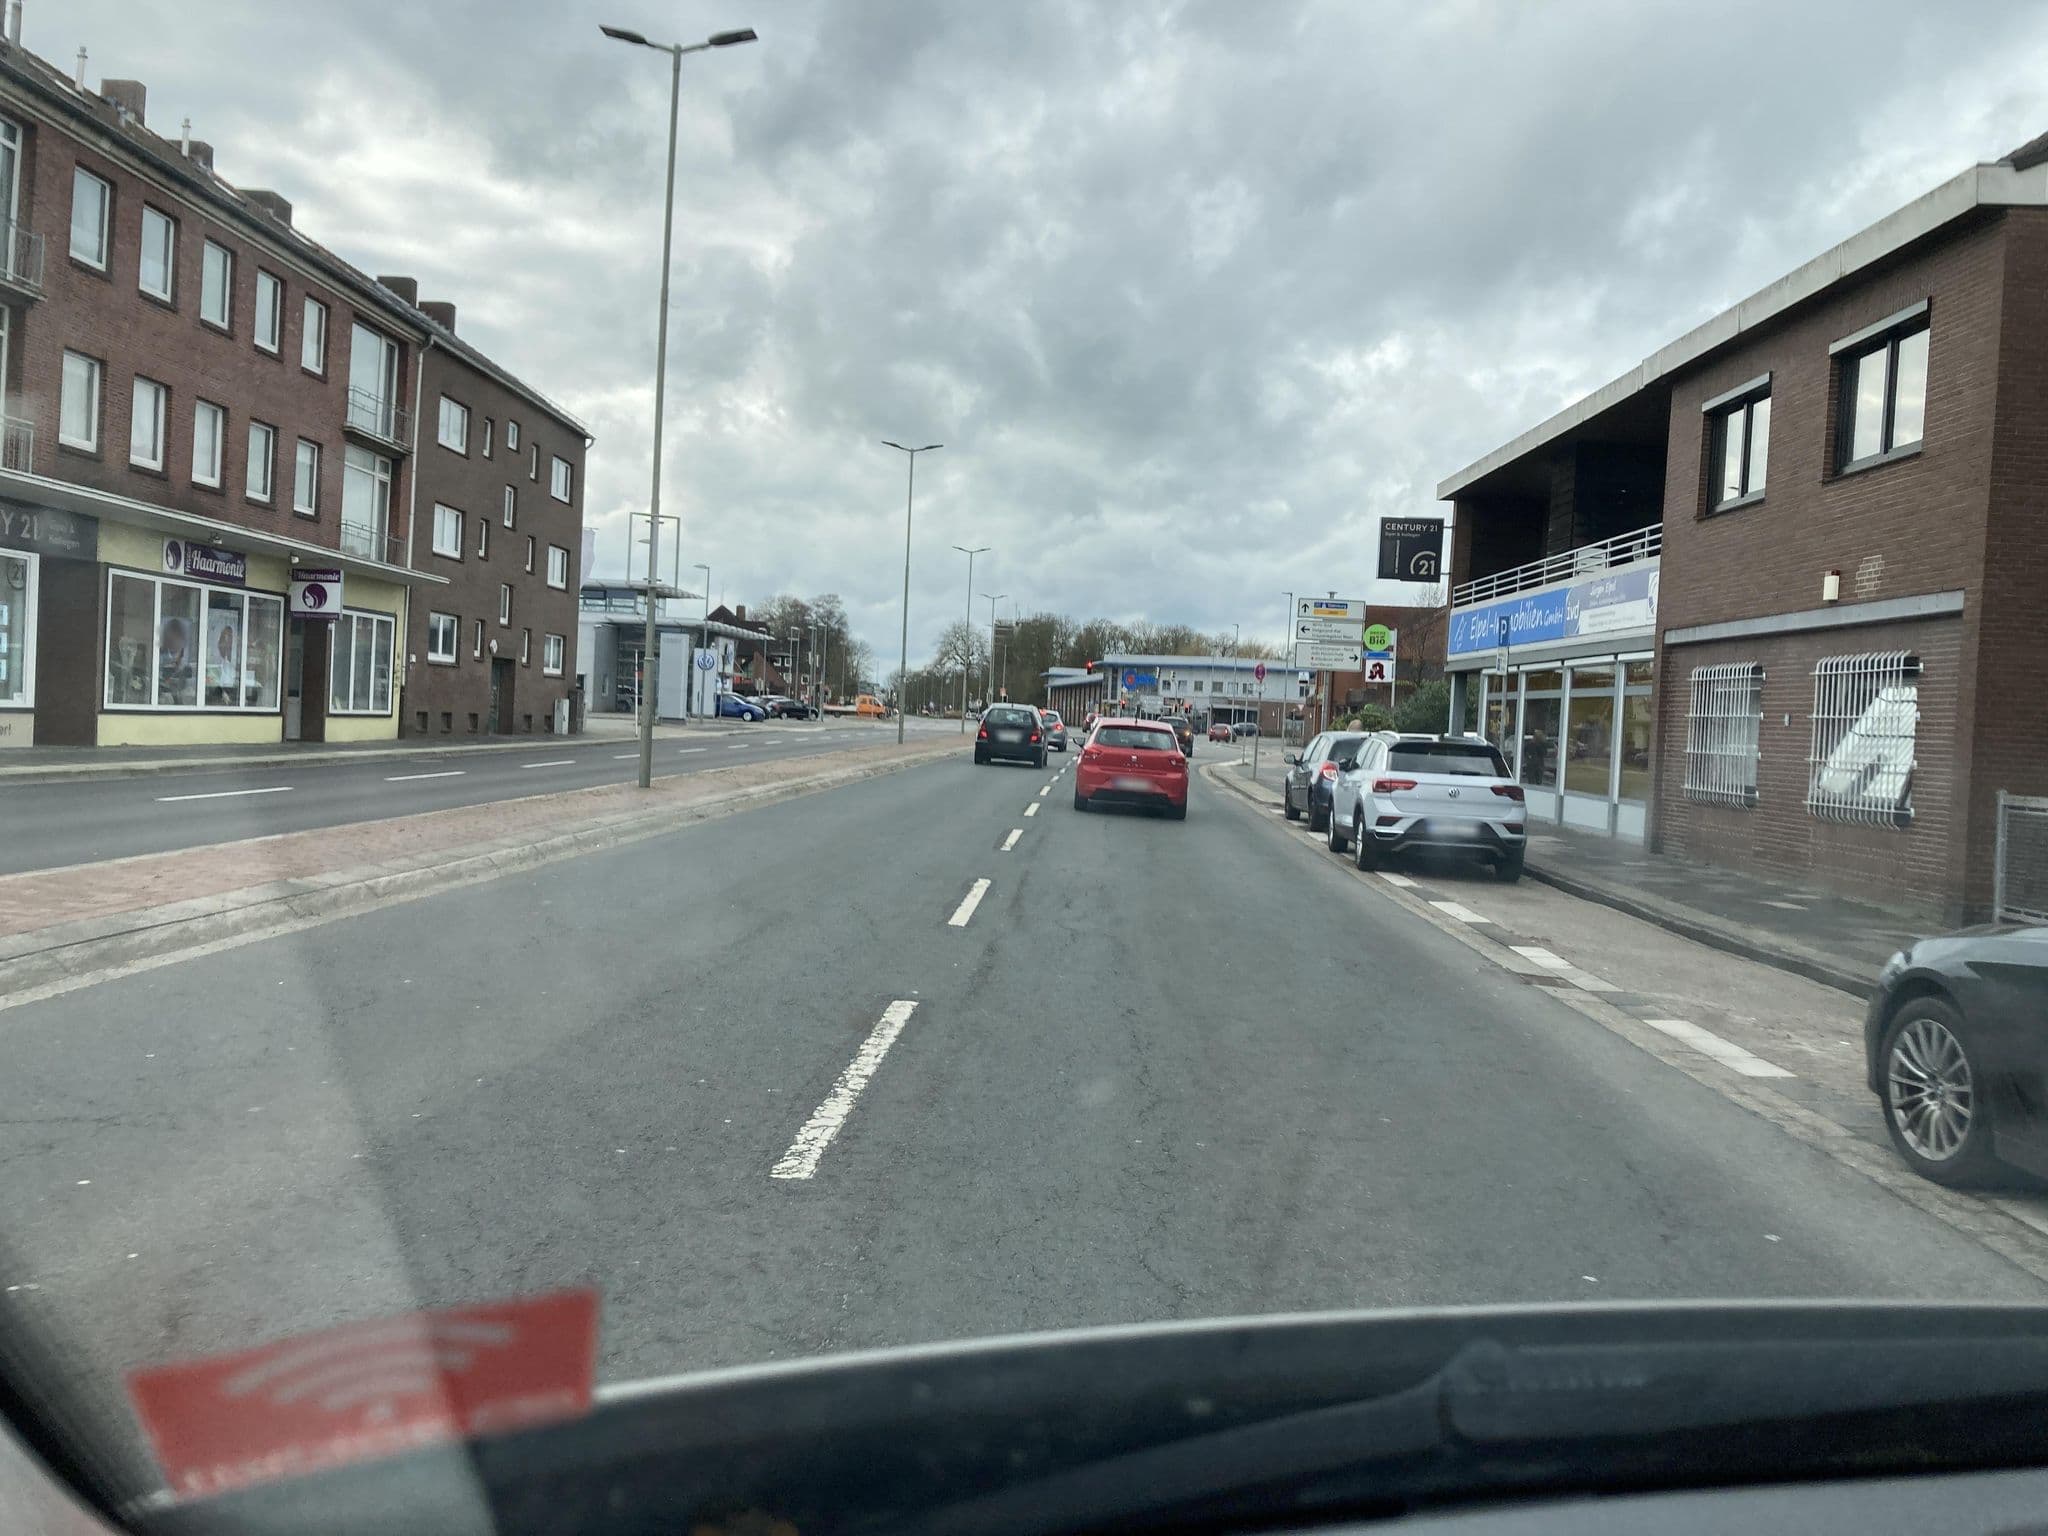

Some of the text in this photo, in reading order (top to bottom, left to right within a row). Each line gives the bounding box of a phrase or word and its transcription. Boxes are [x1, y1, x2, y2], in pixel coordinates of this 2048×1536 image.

[21, 514, 39, 540] 21
[1385, 523, 1428, 532] CENTURY
[191, 549, 246, 578] Haarmonie
[1470, 600, 1564, 647] Elpel-Iobilien GmbH
[1500, 619, 1508, 644] P
[1369, 635, 1386, 645] Bio
